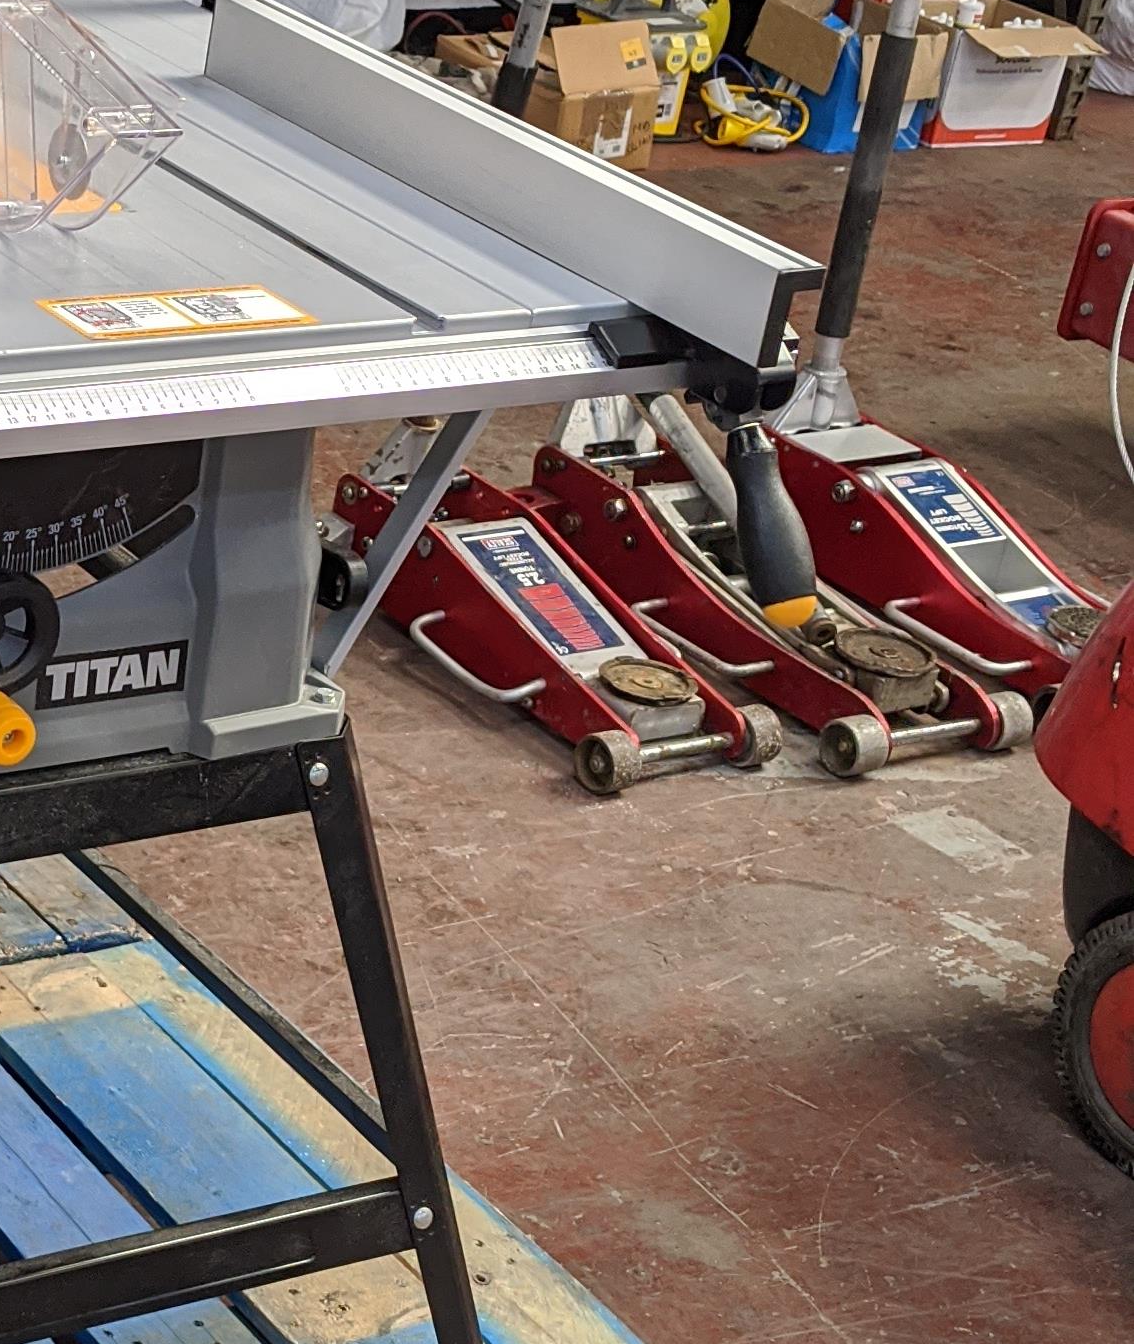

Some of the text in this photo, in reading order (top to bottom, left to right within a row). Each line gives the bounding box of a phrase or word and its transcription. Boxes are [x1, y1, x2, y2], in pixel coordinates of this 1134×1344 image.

[539, 366, 550, 374] 12
[555, 364, 565, 372] 13
[571, 362, 581, 370] 14
[7, 416, 18, 425] 13
[27, 415, 37, 423] 12
[46, 413, 56, 421] 11
[65, 412, 76, 420] 10
[2, 530, 19, 542] 20°
[25, 527, 42, 539] 25°
[48, 521, 64, 534] 30°
[70, 514, 87, 528] 35°
[92, 505, 108, 518] 40°
[114, 493, 129, 508] 45°
[517, 571, 546, 587] 2.5
[45, 648, 181, 701] TITAN
